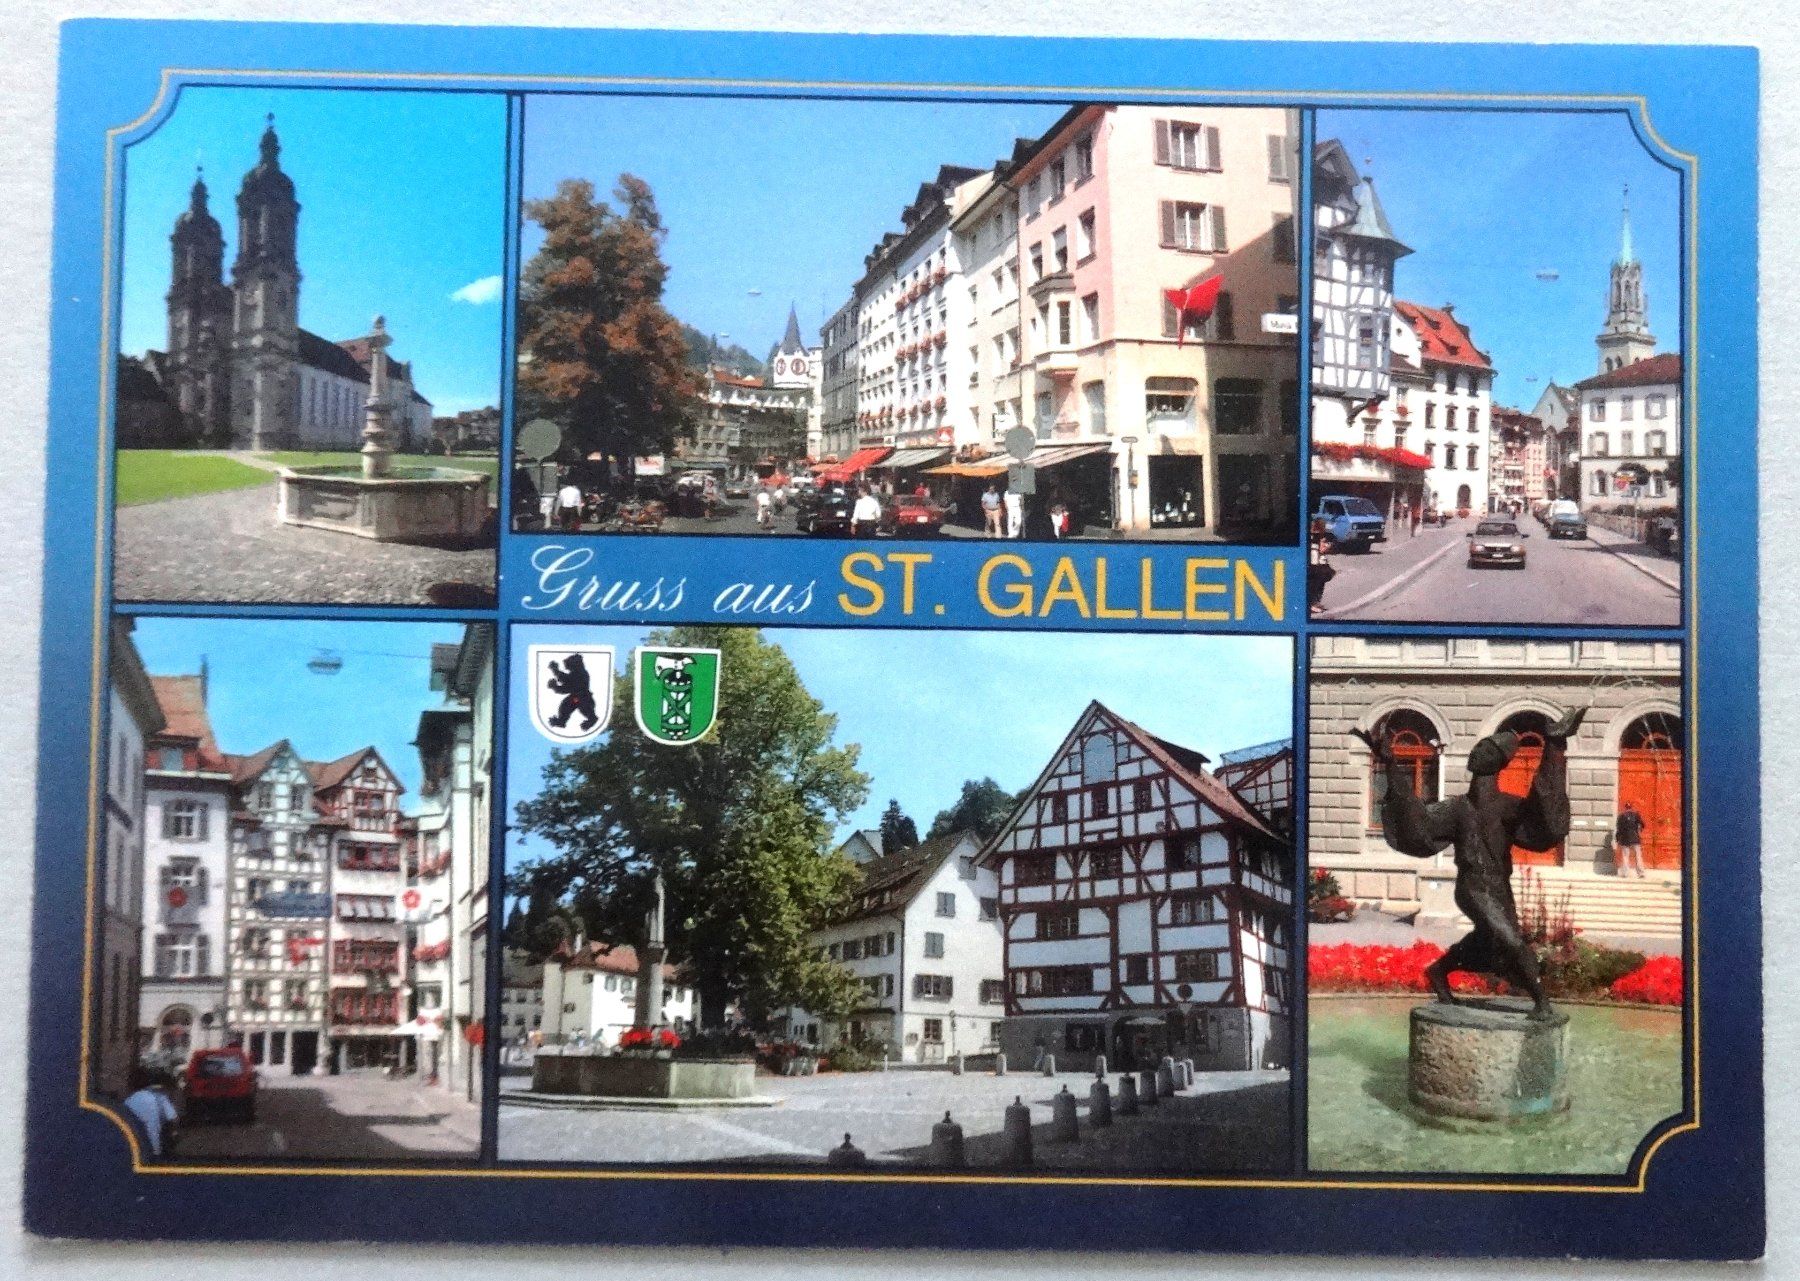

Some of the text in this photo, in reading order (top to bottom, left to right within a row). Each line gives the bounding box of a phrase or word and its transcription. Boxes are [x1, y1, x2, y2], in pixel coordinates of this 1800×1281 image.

[521, 545, 1286, 622] Gruss aus ST. GALLEN
